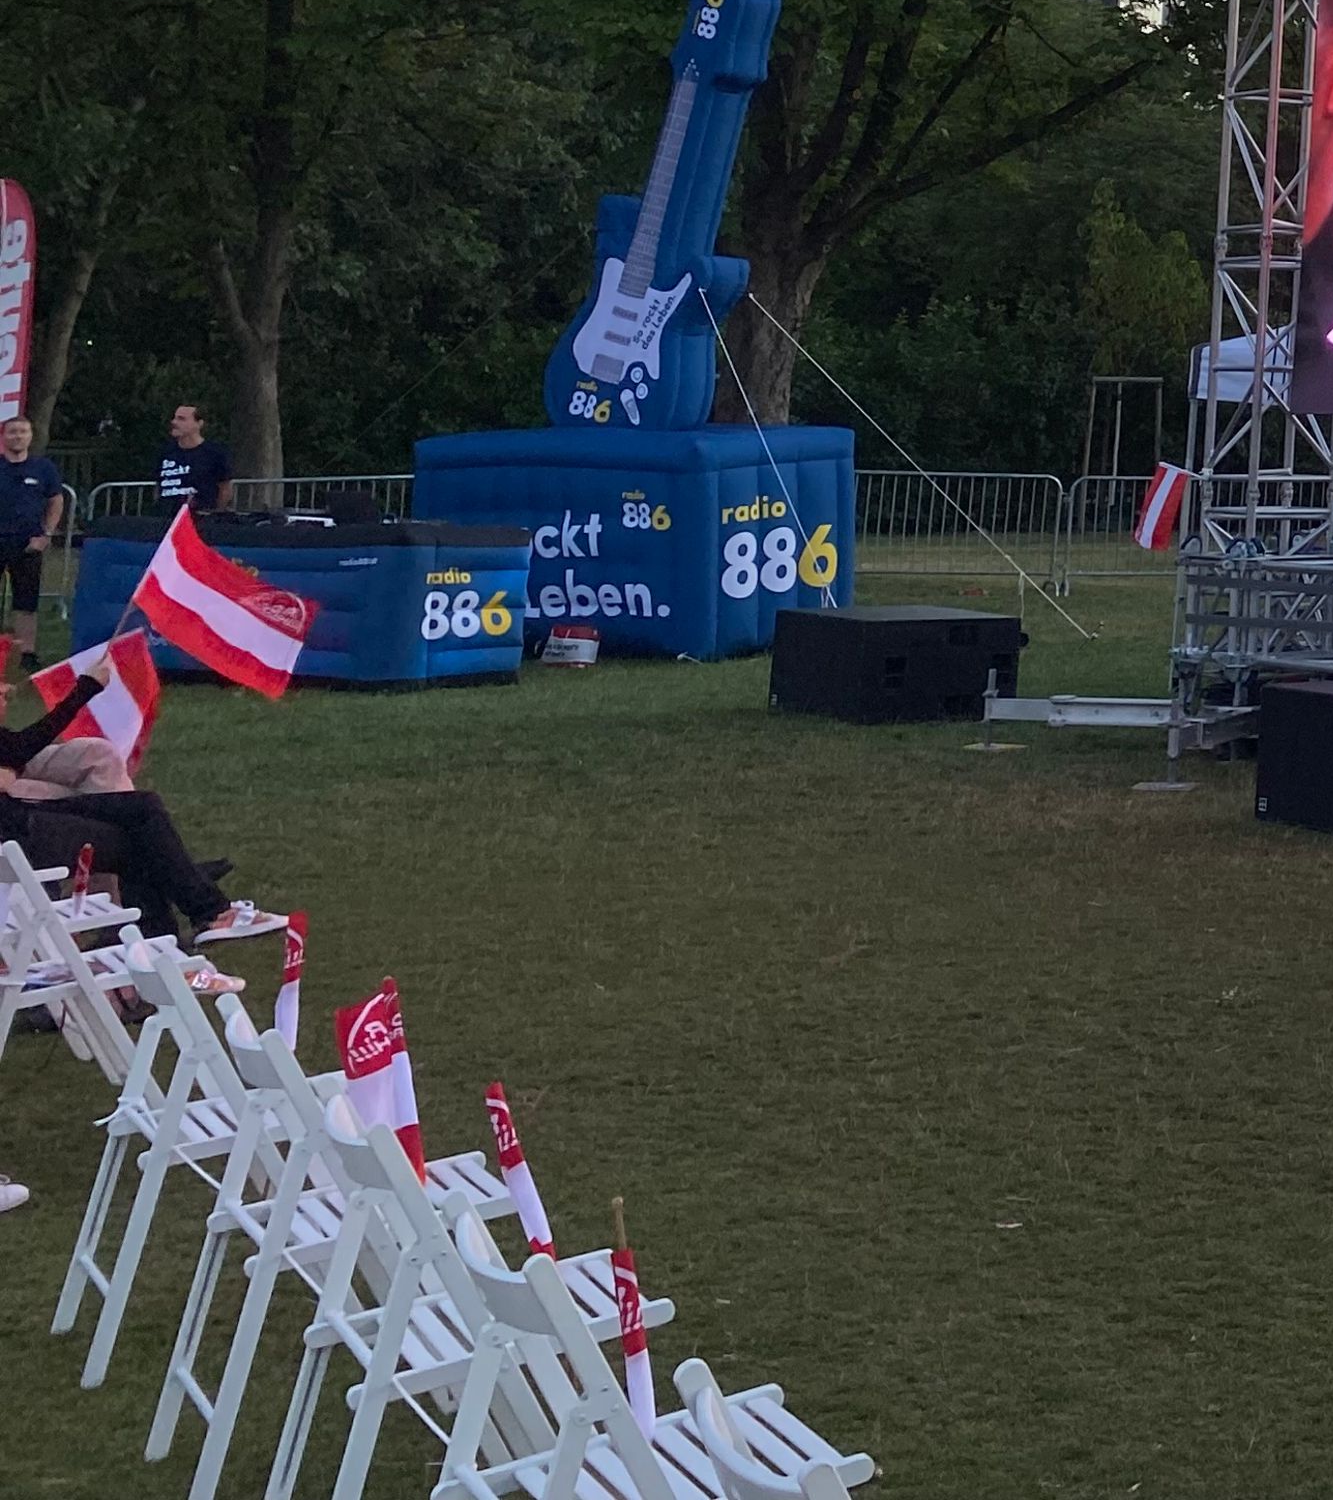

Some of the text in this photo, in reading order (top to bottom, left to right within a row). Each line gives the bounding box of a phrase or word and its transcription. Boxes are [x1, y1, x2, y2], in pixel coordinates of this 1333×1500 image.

[641, 329, 656, 350] das
[568, 390, 612, 424] 886
[622, 502, 672, 531] 886
[721, 495, 787, 524] radio
[528, 509, 603, 559] ckt
[426, 567, 472, 585] radio
[720, 523, 839, 599] 886
[421, 590, 513, 641] 886
